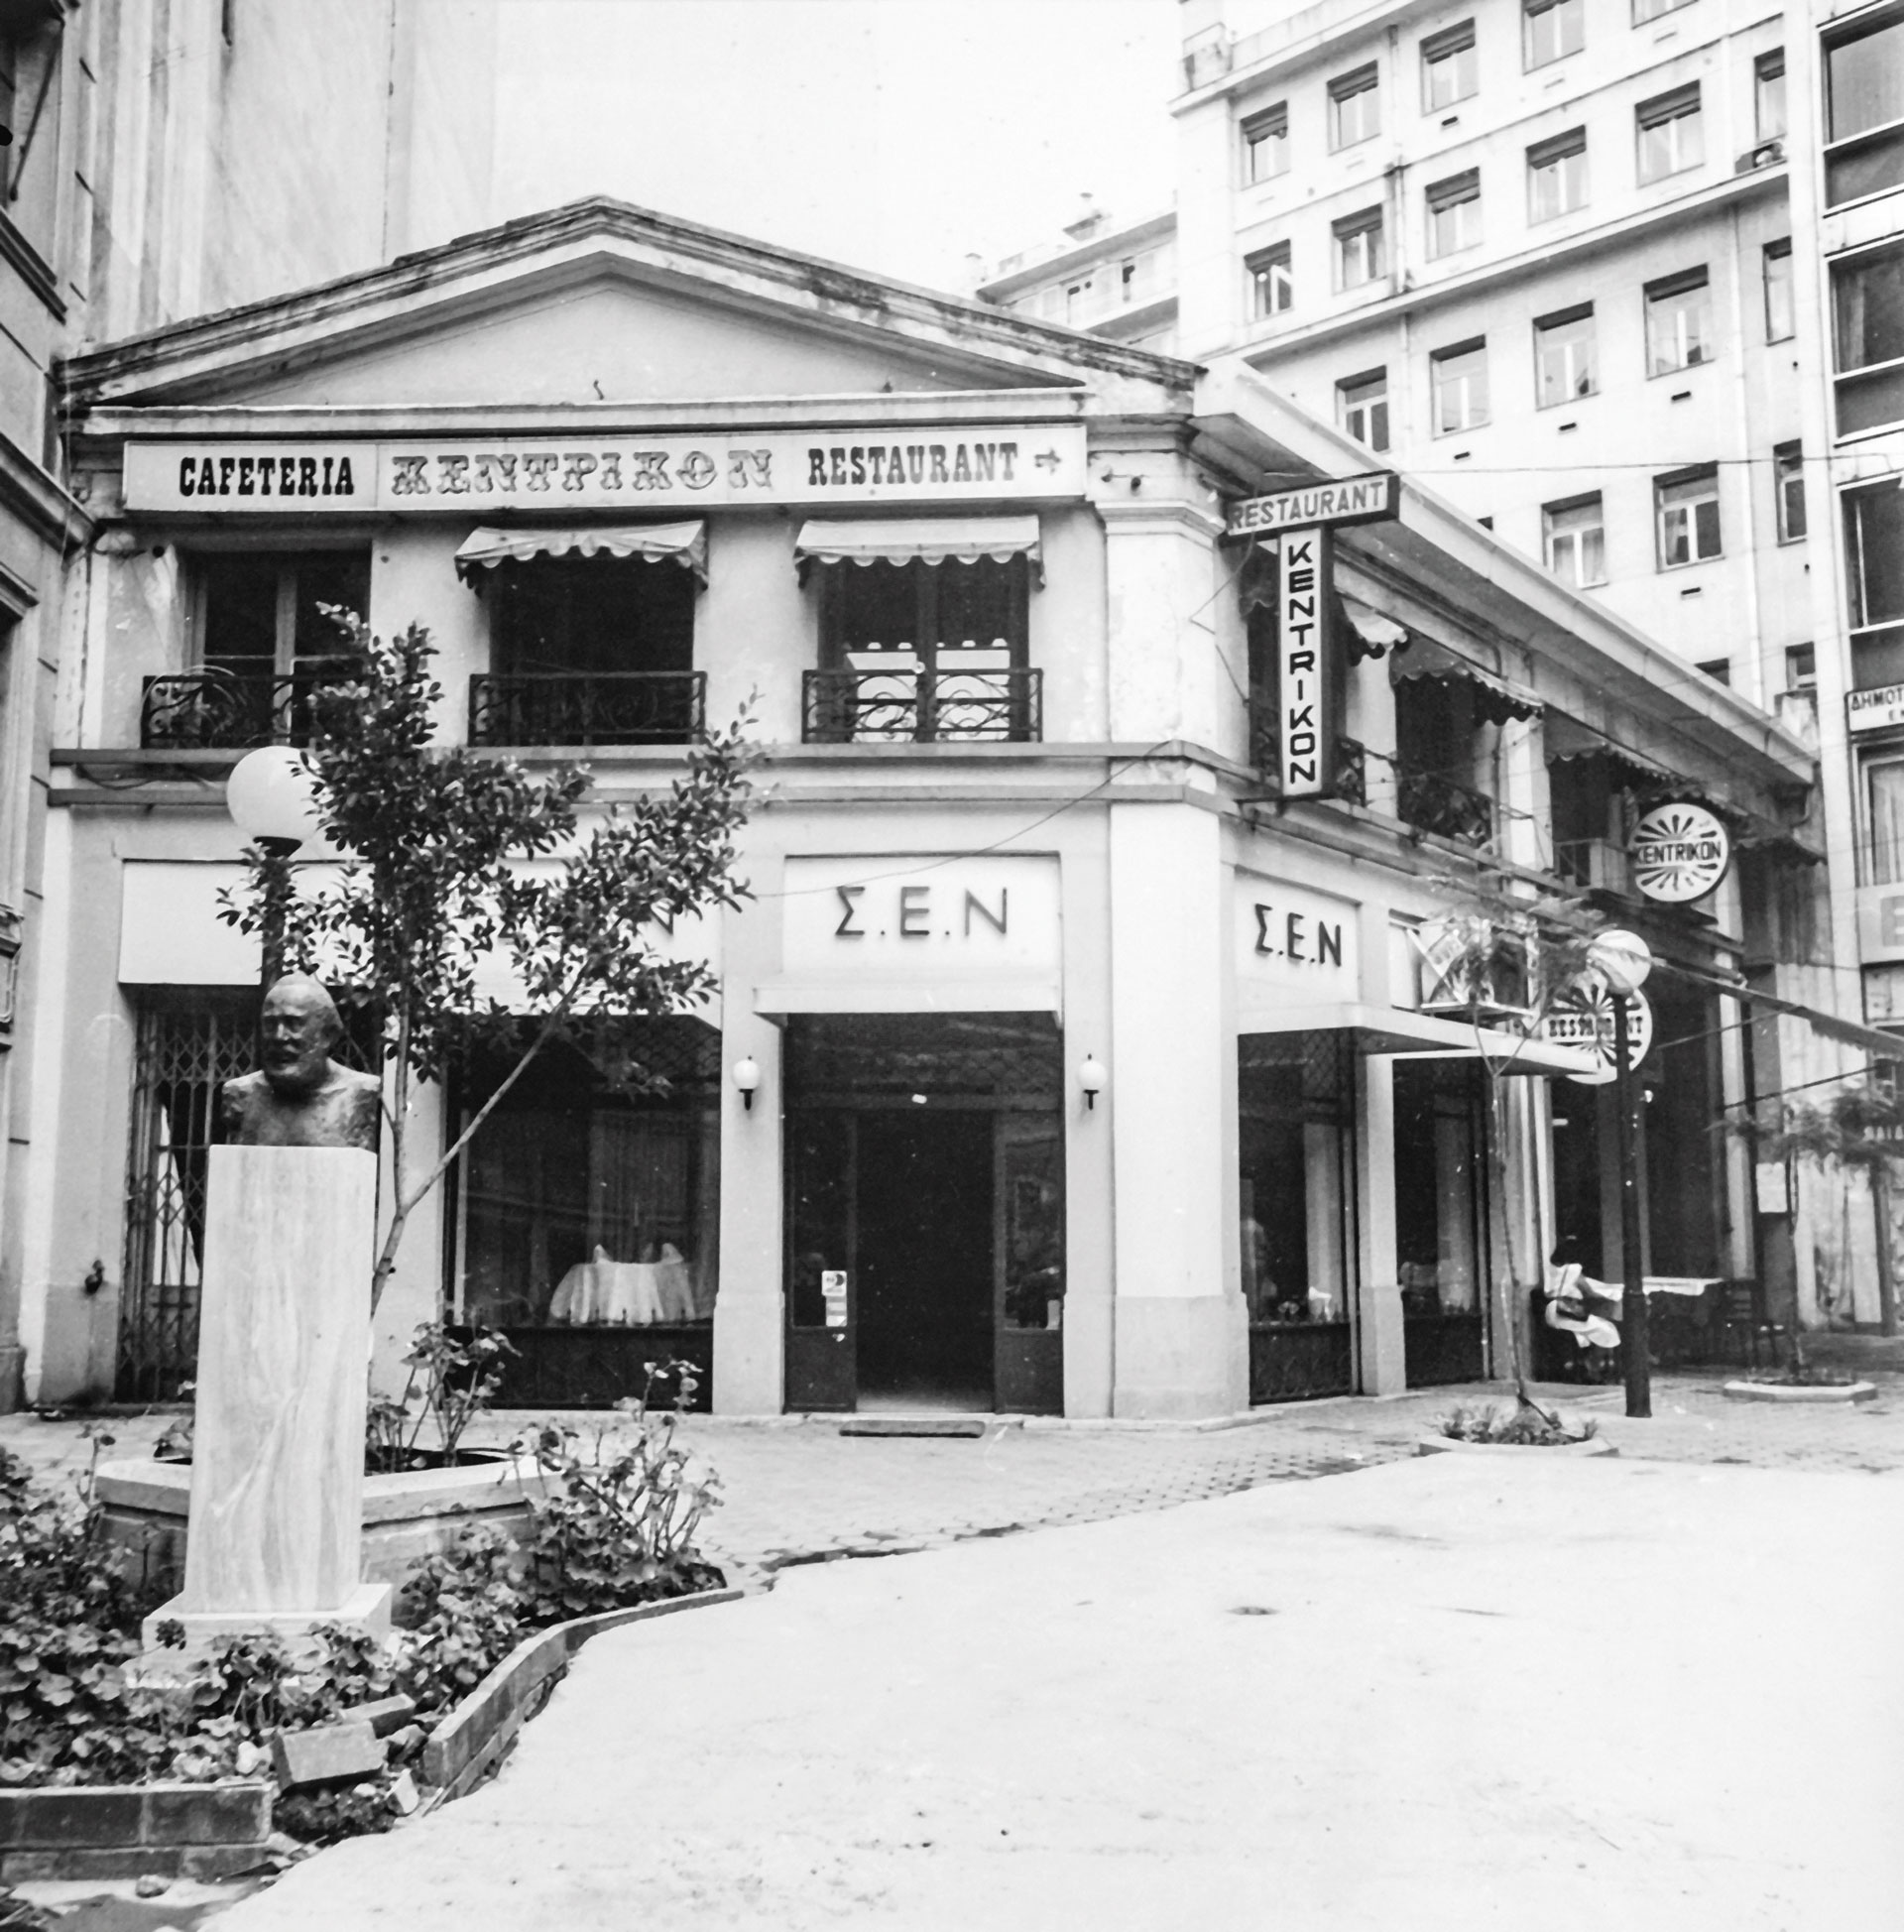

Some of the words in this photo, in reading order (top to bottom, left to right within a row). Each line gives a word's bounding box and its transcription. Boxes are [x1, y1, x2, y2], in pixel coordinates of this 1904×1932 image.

[179, 457, 354, 496] CAFETERIA
[392, 449, 773, 495] ΚΕΝΤΡΙΚΟΝ
[808, 442, 1017, 485] RESTAURANT
[1229, 481, 1383, 530] RESTAURANT
[1288, 541, 1316, 785] KENTRIKON
[835, 886, 1008, 936] Σ.Ε.Ν
